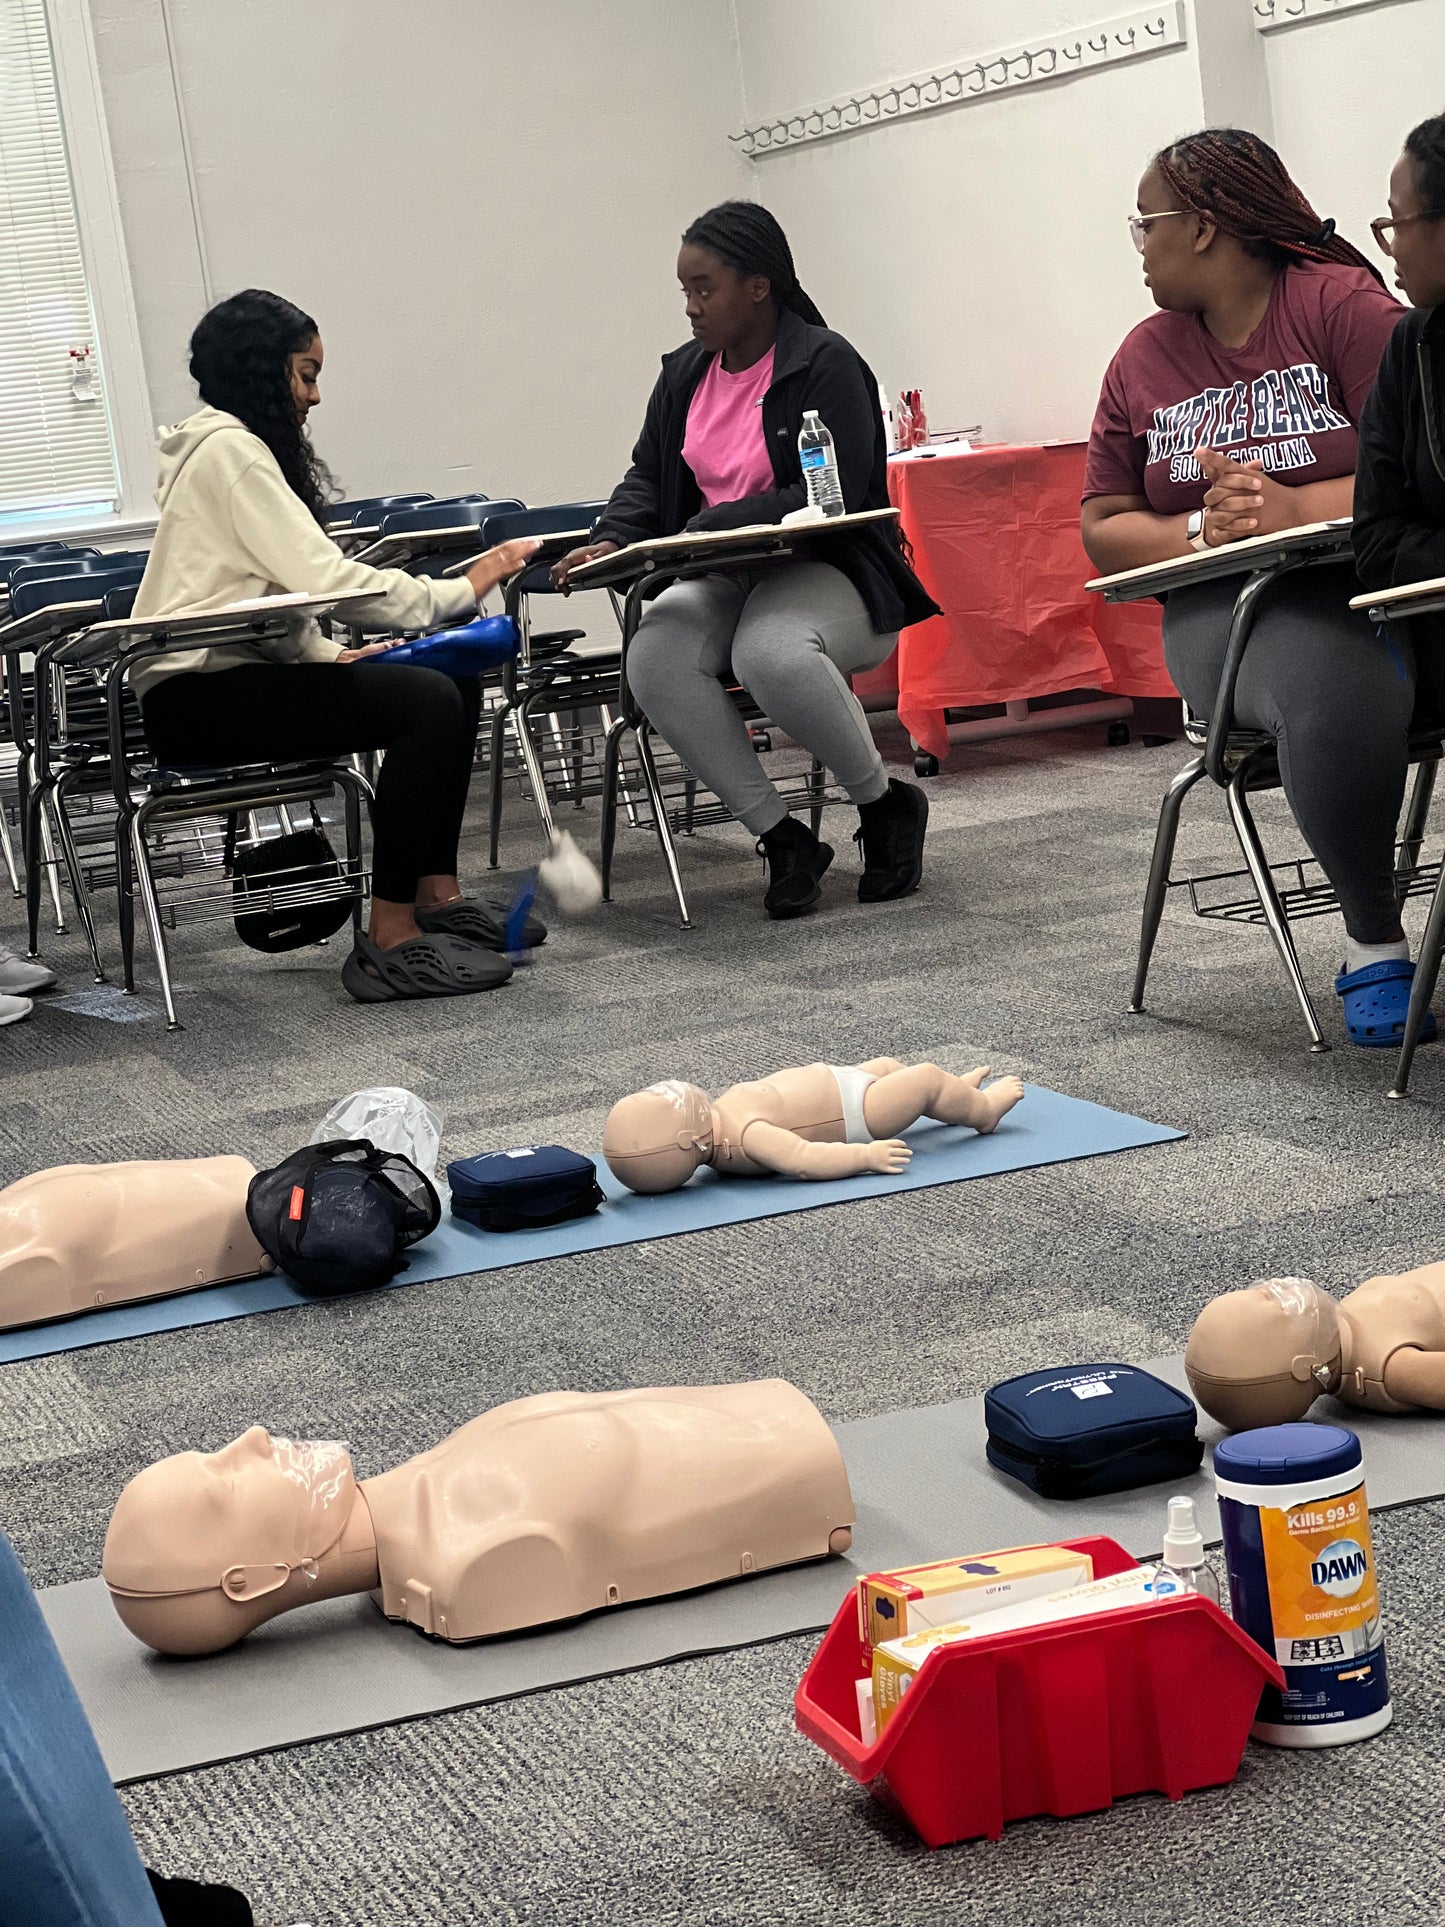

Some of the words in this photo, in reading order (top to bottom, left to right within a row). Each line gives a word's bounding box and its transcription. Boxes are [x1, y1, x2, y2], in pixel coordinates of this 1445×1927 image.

[1147, 381, 1248, 465] MYRTLE
[1250, 363, 1351, 438] BEACH
[1288, 1513, 1324, 1529] Kills
[1326, 1502, 1360, 1523] 99.9
[1311, 1549, 1368, 1586] DAWN
[985, 1587, 997, 1595] LOT
[1305, 1604, 1361, 1622] DISINFECTING
